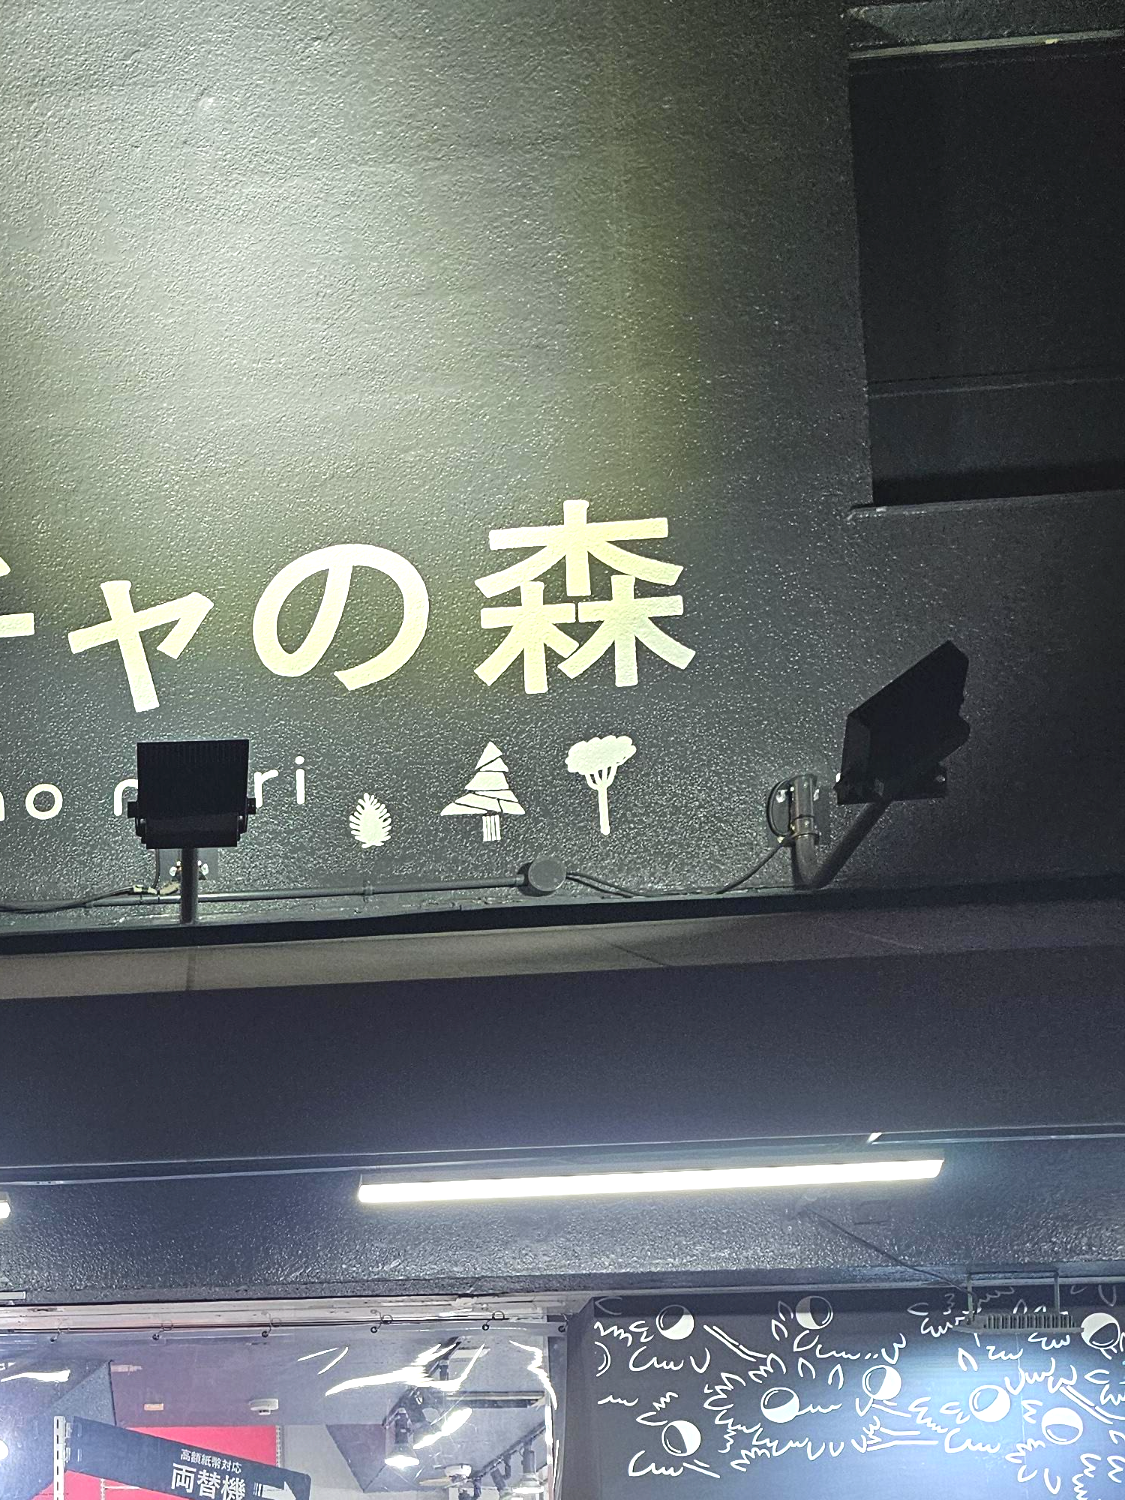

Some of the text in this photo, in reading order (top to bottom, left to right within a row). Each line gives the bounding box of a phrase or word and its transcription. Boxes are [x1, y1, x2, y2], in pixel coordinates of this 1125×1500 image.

[181, 1449, 242, 1474] 高額紙幣対応
